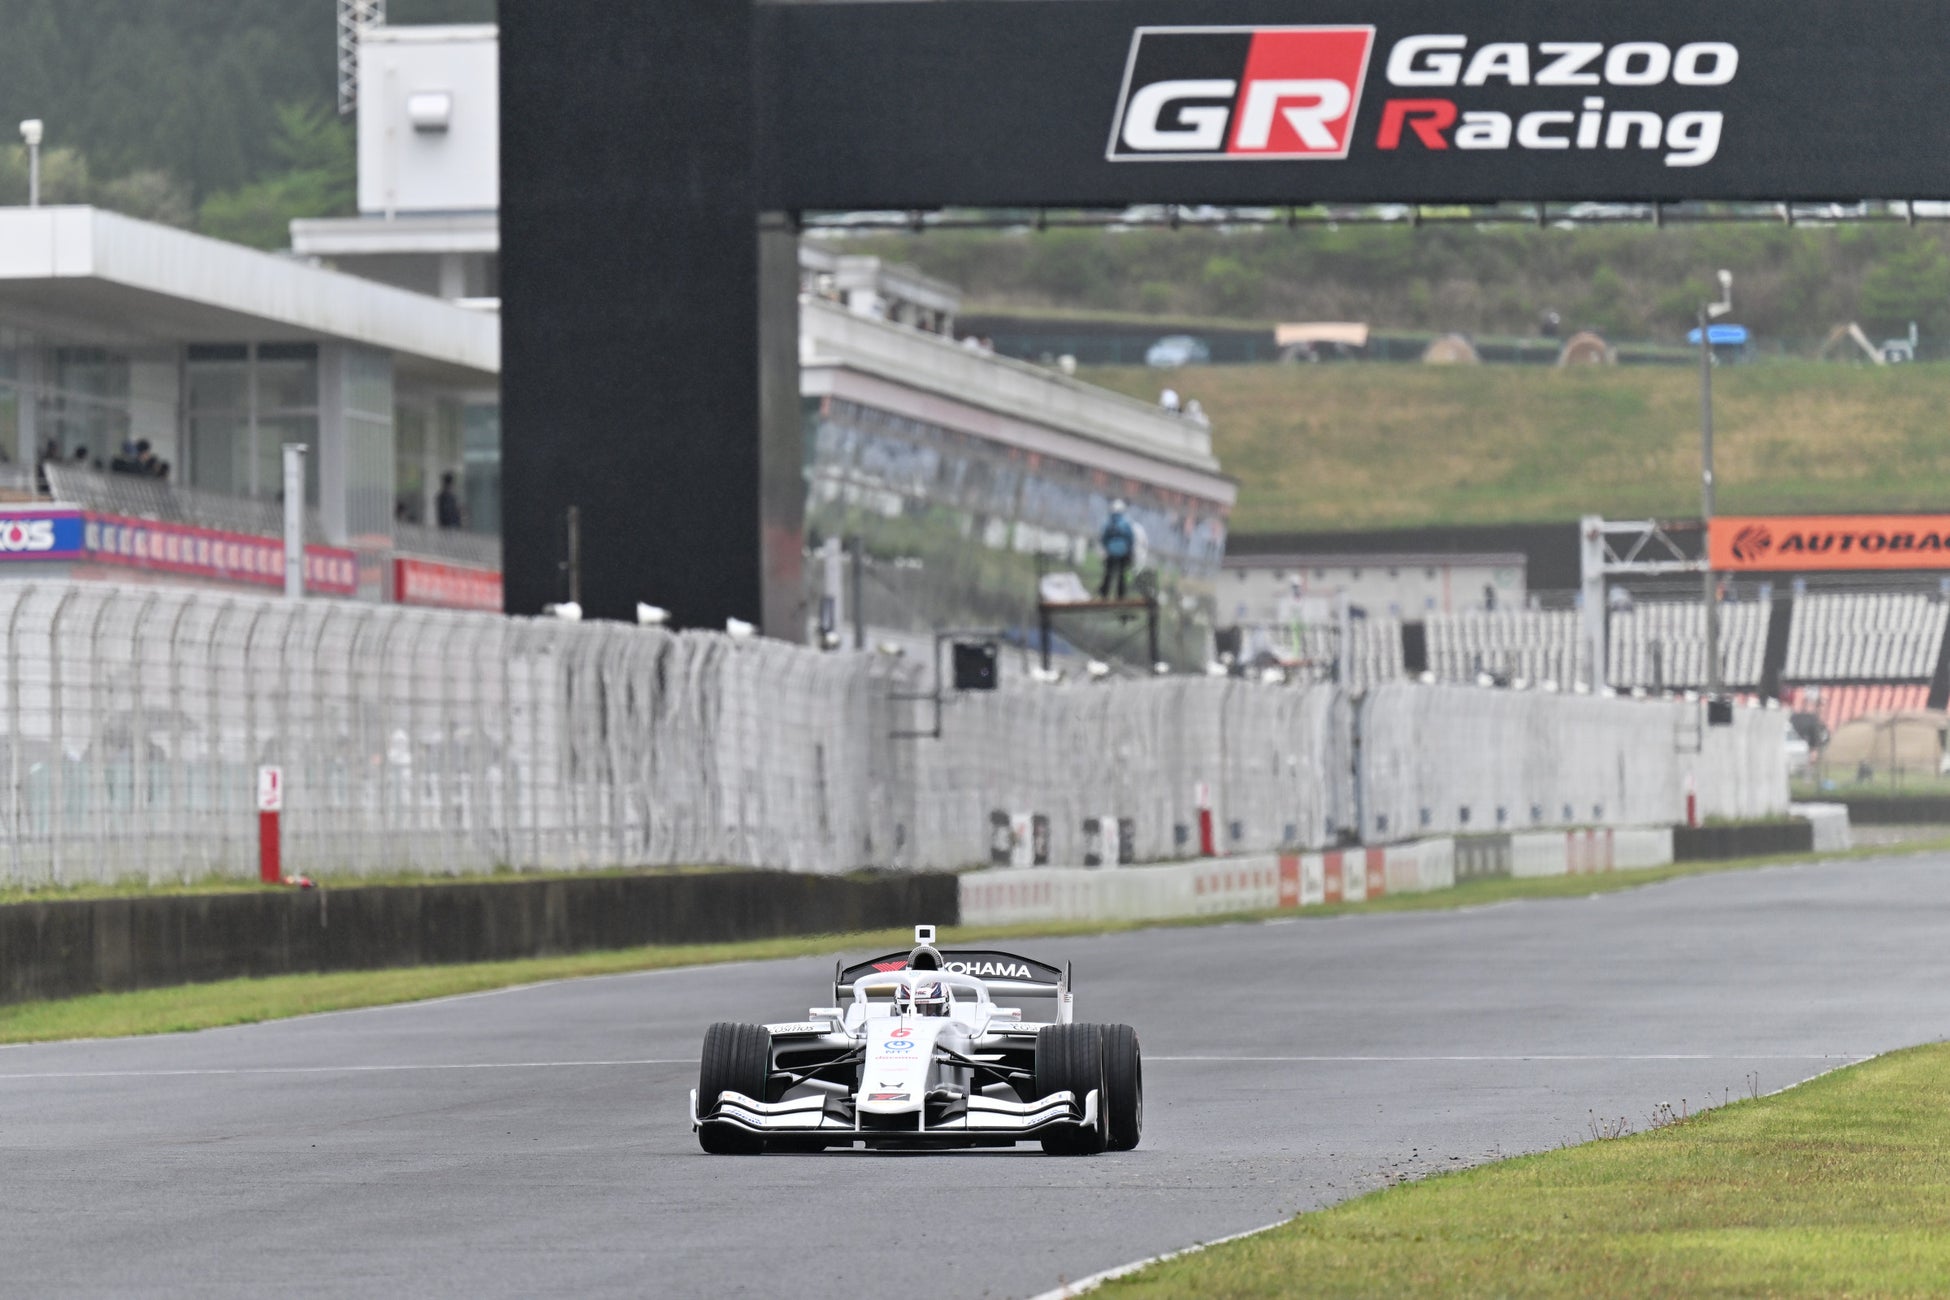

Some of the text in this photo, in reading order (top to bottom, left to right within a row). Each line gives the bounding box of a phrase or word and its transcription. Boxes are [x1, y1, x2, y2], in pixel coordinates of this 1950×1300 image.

[1385, 34, 1739, 87] GAZOO
[1120, 77, 1352, 151] GR
[1375, 97, 1724, 167] Racing
[0, 519, 55, 551] OS
[890, 1028, 912, 1038] 6
